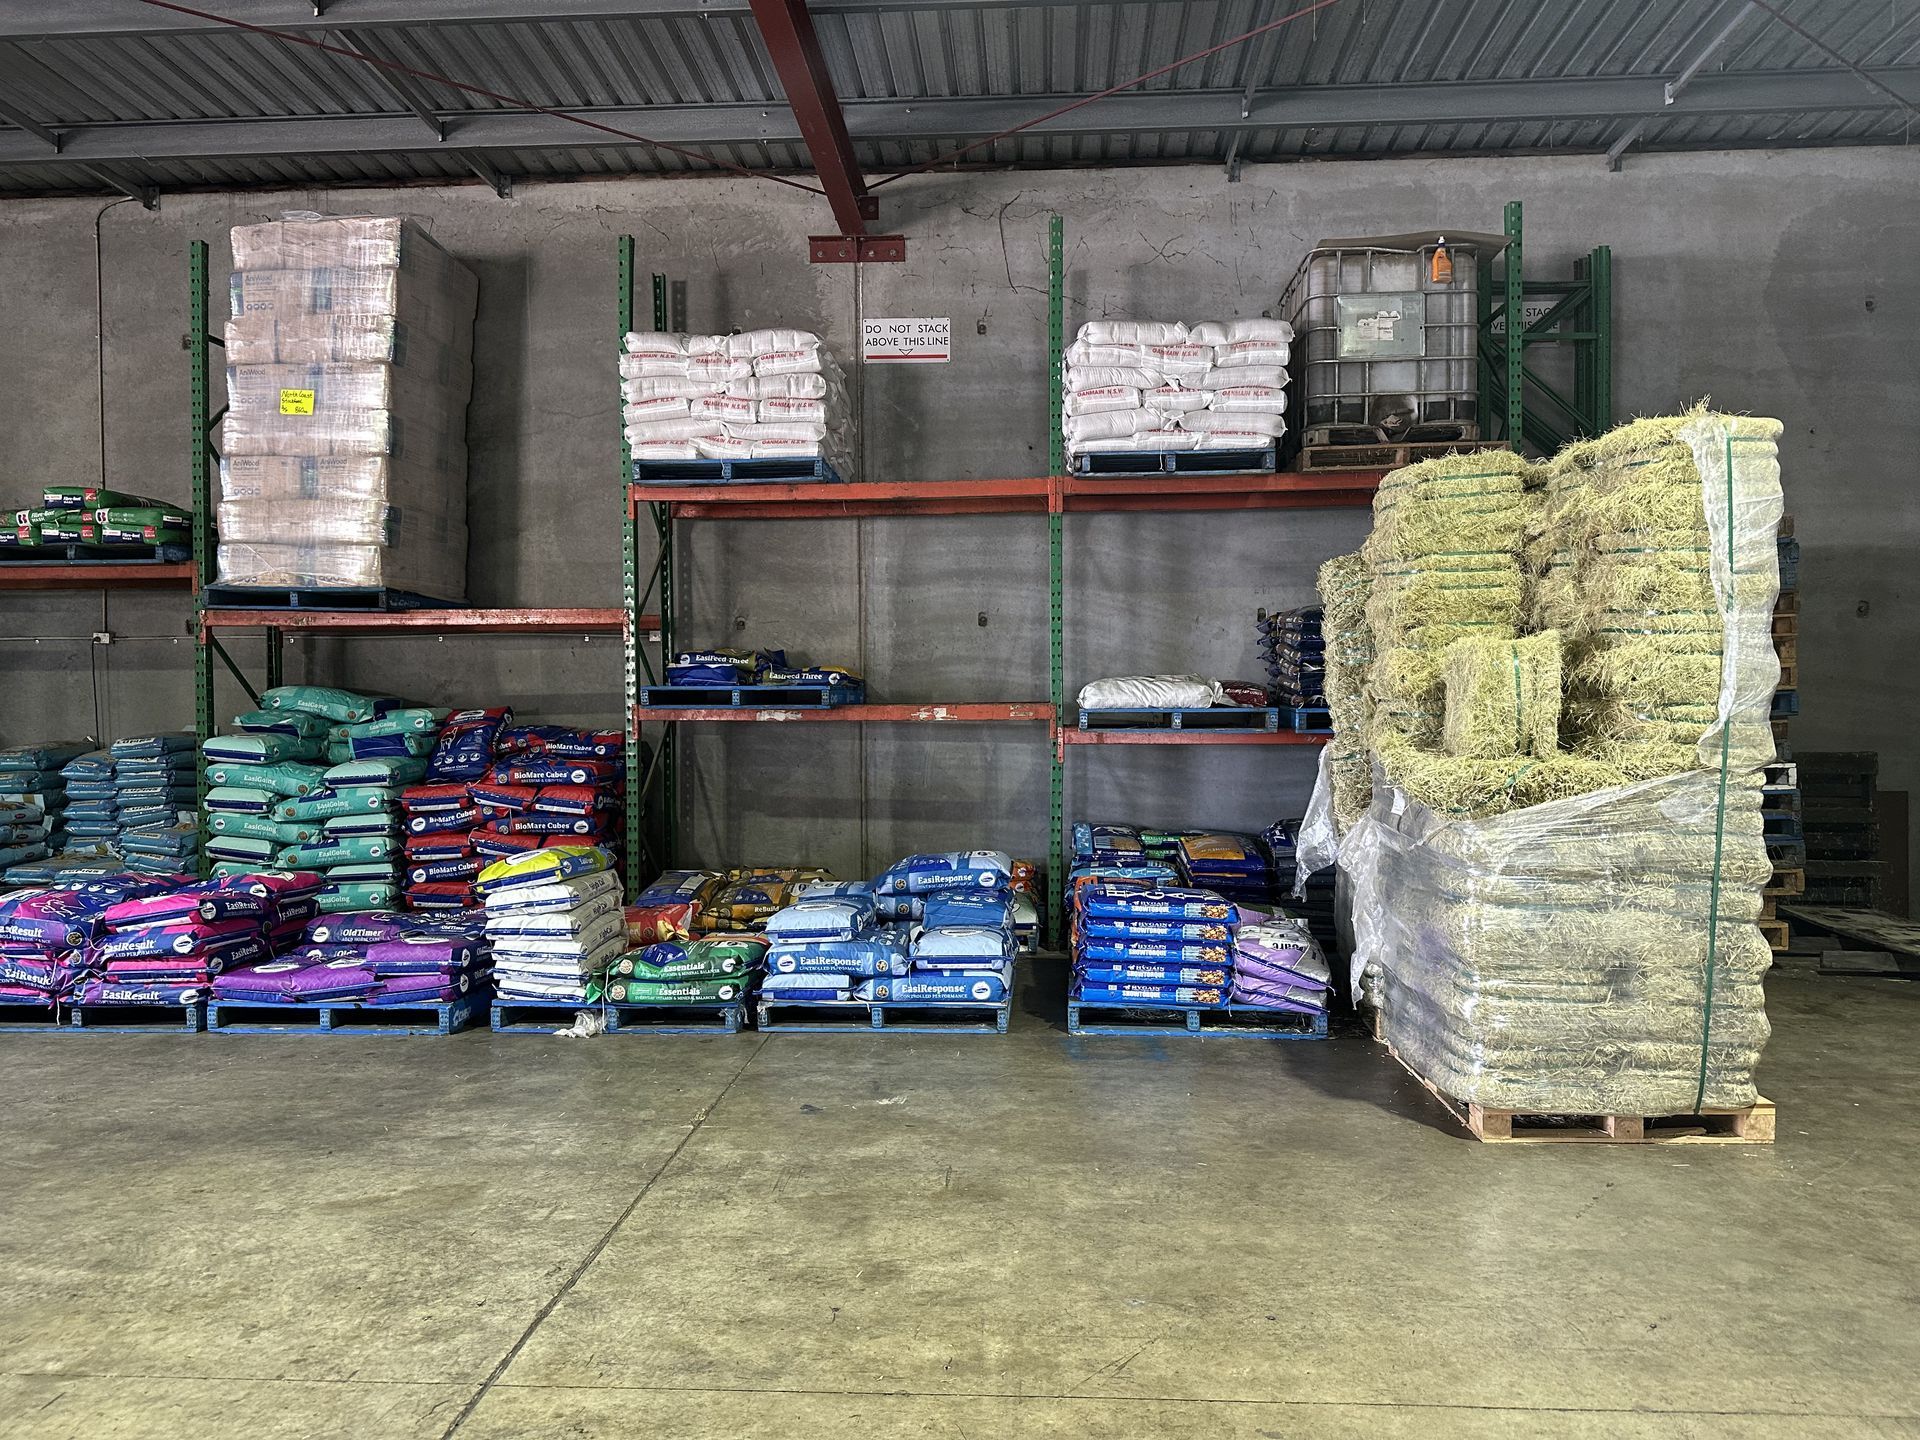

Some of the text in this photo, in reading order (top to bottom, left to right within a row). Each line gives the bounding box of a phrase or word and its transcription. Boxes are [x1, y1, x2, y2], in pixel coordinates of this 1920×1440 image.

[1526, 308, 1551, 317] STAC
[866, 324, 949, 334] DO NOT STACK
[865, 336, 949, 346] ABOVE THIS LINE
[456, 809, 476, 818] Cubes
[429, 862, 478, 875] BioMare Cubes
[918, 875, 972, 885] EasiResponse
[0, 926, 43, 937] asiResult
[800, 957, 861, 966] EasiResponse
[664, 962, 704, 972] Essentials
[902, 985, 965, 994] EasiResponse
[102, 990, 160, 1000] EasiResult
